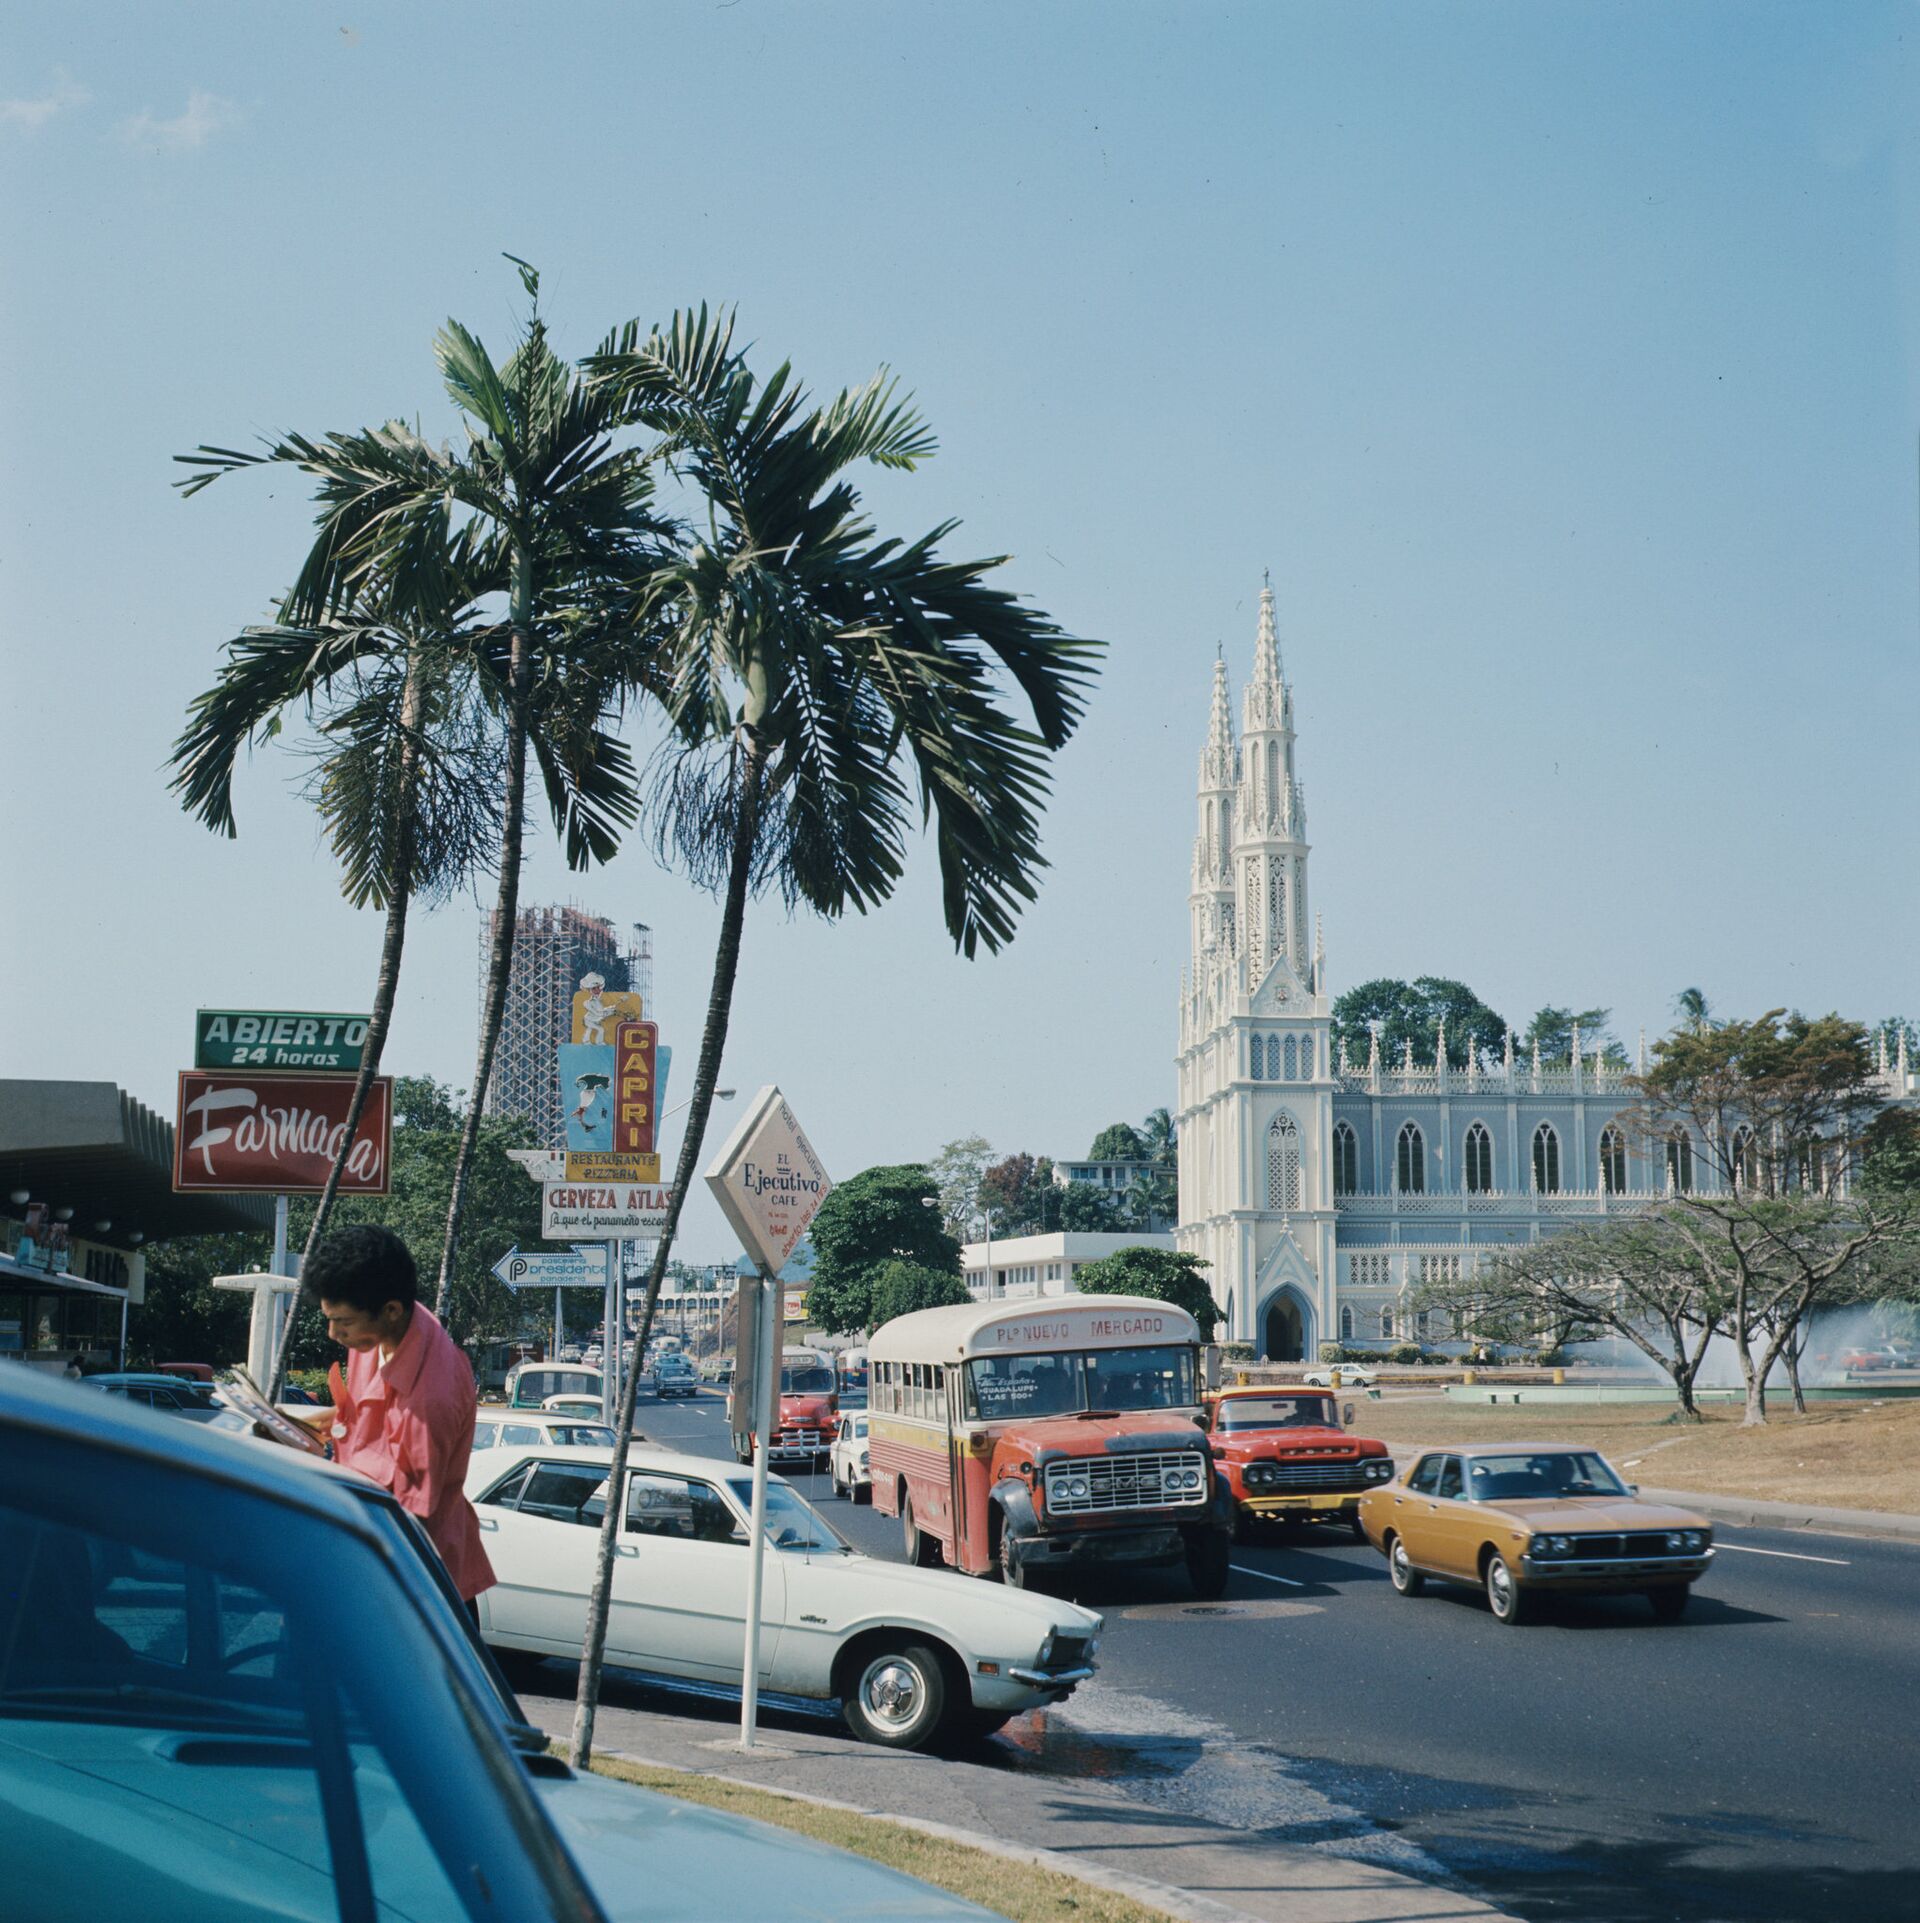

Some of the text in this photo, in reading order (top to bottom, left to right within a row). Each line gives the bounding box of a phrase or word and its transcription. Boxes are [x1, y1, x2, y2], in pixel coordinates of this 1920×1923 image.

[204, 1017, 369, 1047] ABIERTO
[231, 1047, 340, 1066] 24 horas
[622, 1029, 650, 1148] CAPRI
[186, 1084, 380, 1182] Farmaca
[780, 1103, 822, 1180] hotel ejecutivo
[570, 1152, 657, 1166] RESTAURANTE
[777, 1153, 790, 1165] EL
[584, 1168, 639, 1181] PIZZERIA
[744, 1163, 820, 1195] Ejecutivo
[548, 1188, 617, 1209] CERVEZA
[771, 1194, 799, 1206] CAFE
[561, 1215, 579, 1230] que
[581, 1212, 593, 1226] el
[594, 1214, 641, 1231] panameño
[529, 1264, 607, 1275] presidente
[1023, 1323, 1069, 1341] NUEVO
[1091, 1317, 1163, 1337] MERCADO
[982, 1384, 1034, 1394] GUADALUPE
[987, 1393, 1006, 1401] LAS
